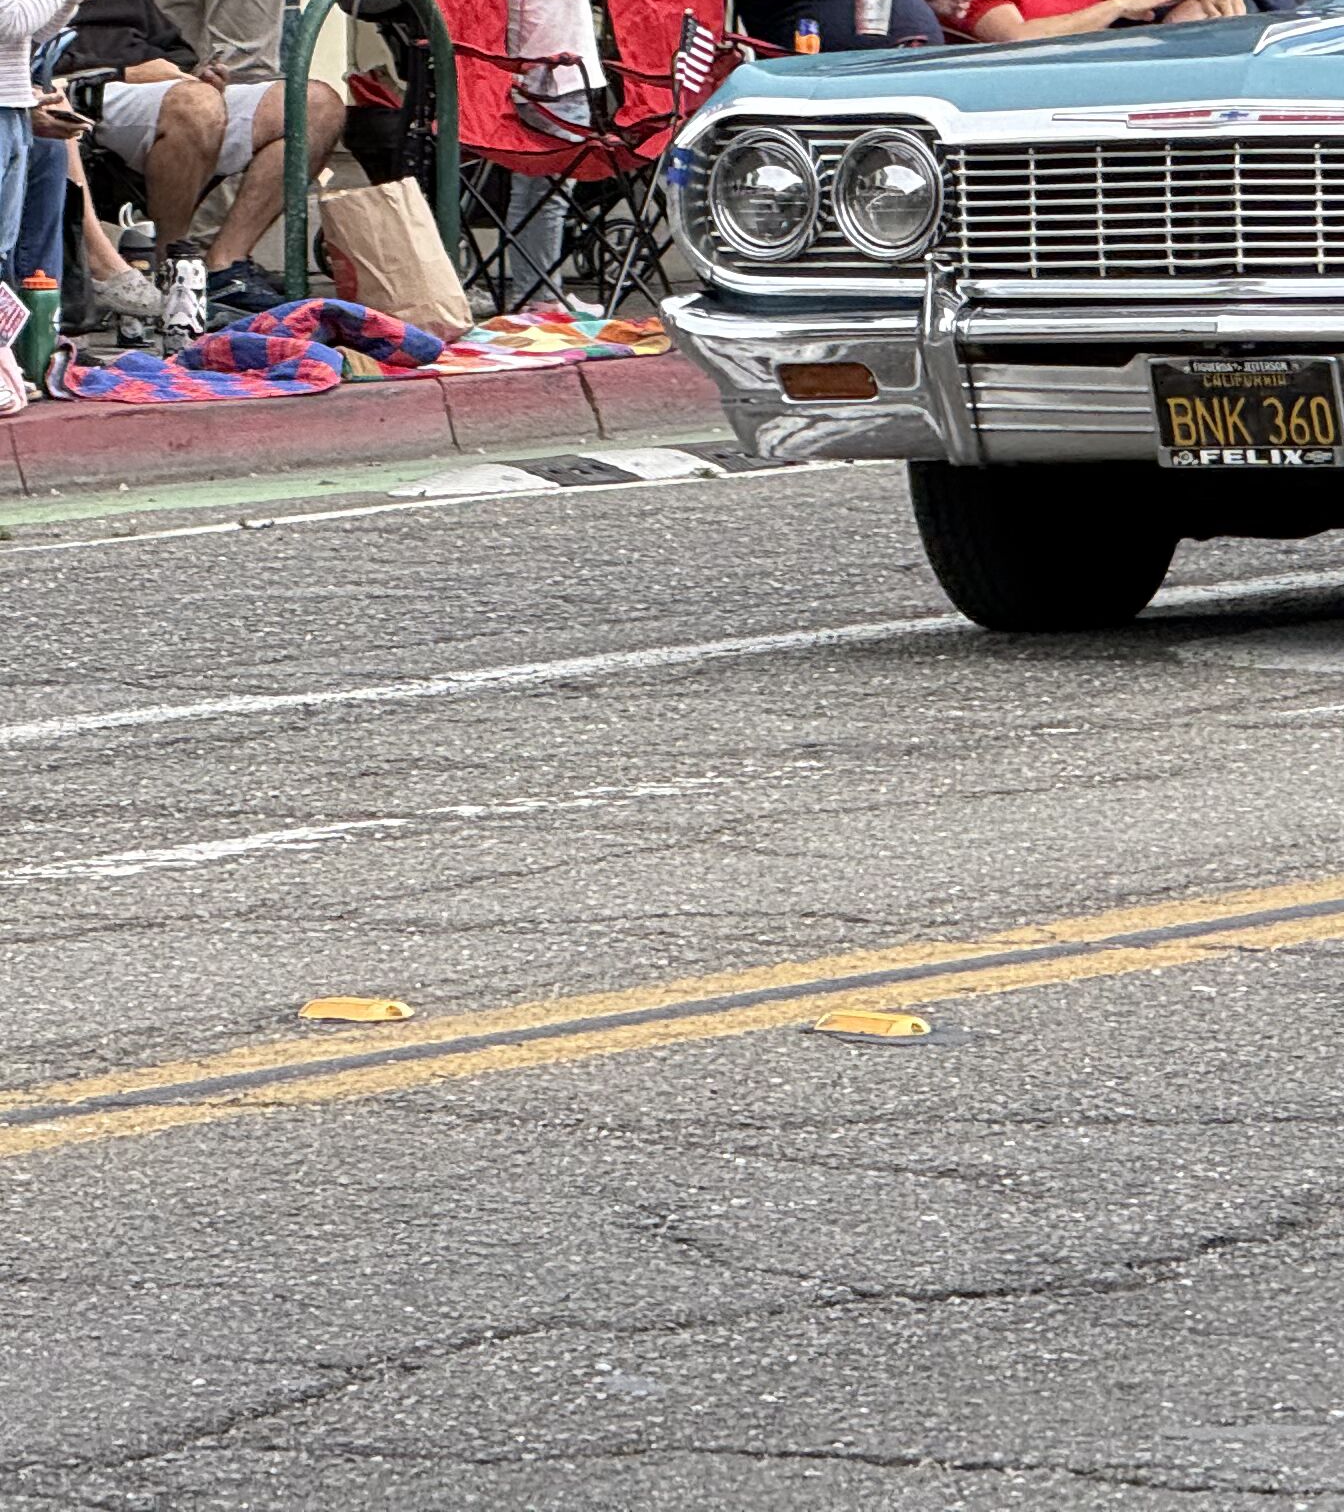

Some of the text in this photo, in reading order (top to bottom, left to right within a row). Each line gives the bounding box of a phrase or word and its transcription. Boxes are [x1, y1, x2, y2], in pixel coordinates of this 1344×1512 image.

[1167, 396, 1335, 446] BNK 360
[1200, 448, 1304, 465] FELIX
